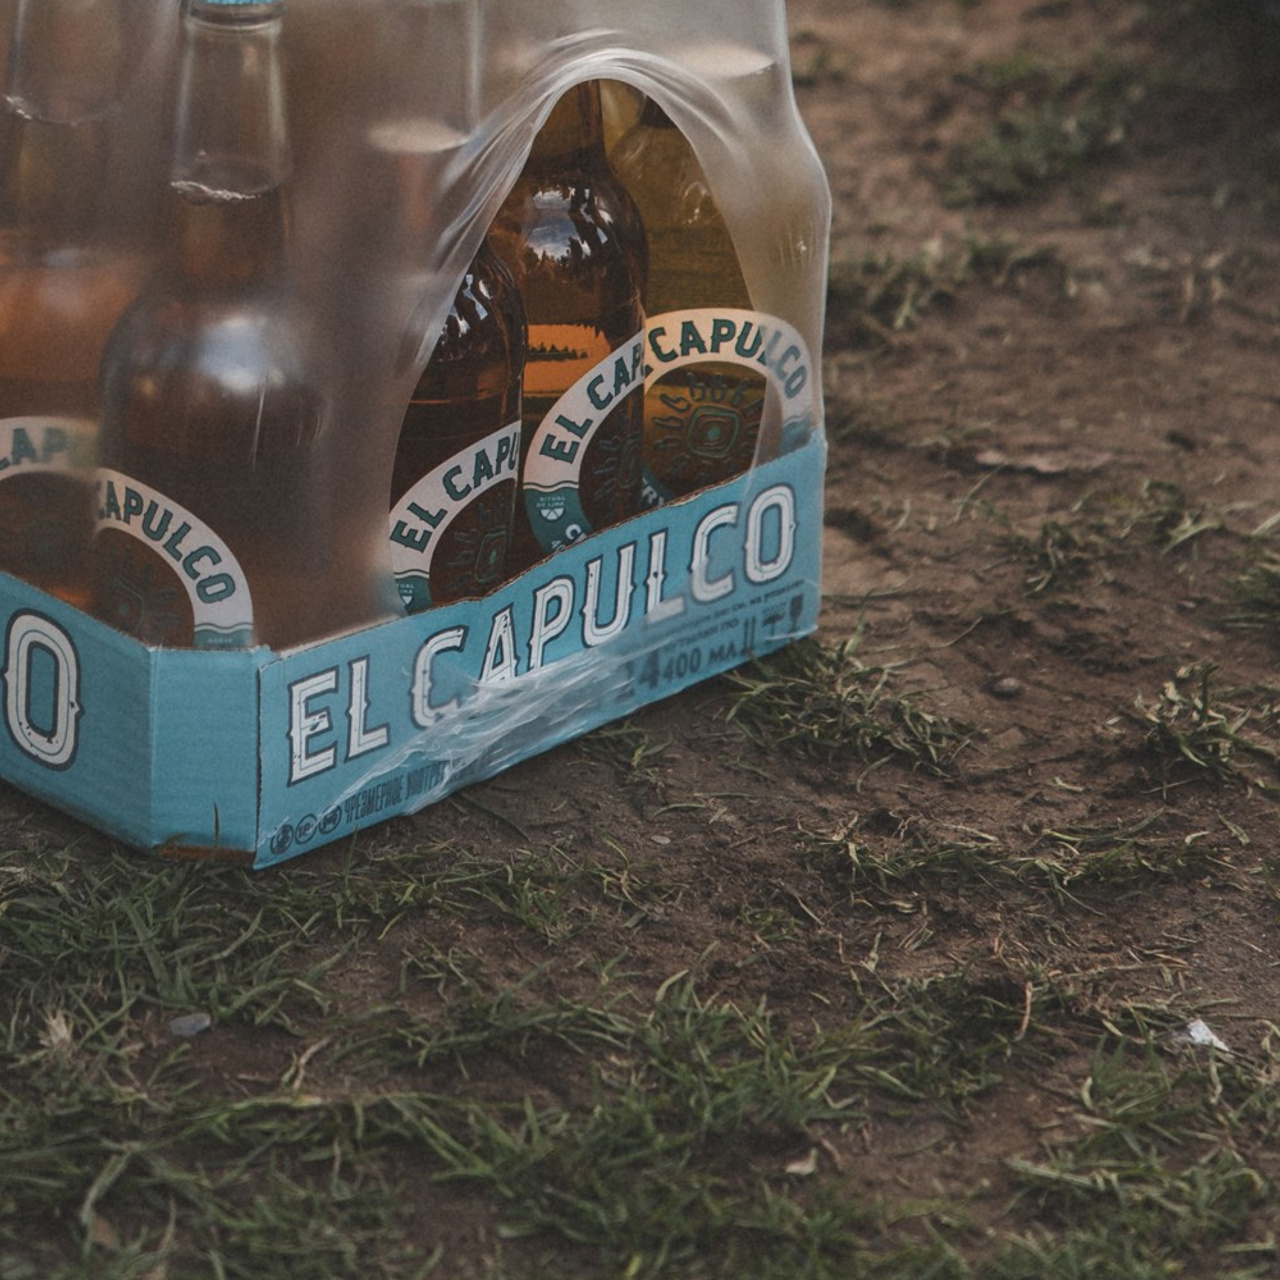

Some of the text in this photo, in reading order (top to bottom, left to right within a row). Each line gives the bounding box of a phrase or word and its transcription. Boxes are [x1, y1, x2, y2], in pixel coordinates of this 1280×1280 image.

[648, 318, 808, 400] CAPULCO
[539, 413, 593, 465] EL
[389, 501, 448, 553] EL
[286, 483, 800, 788] EL CAPULCO
[663, 647, 702, 682] 400
